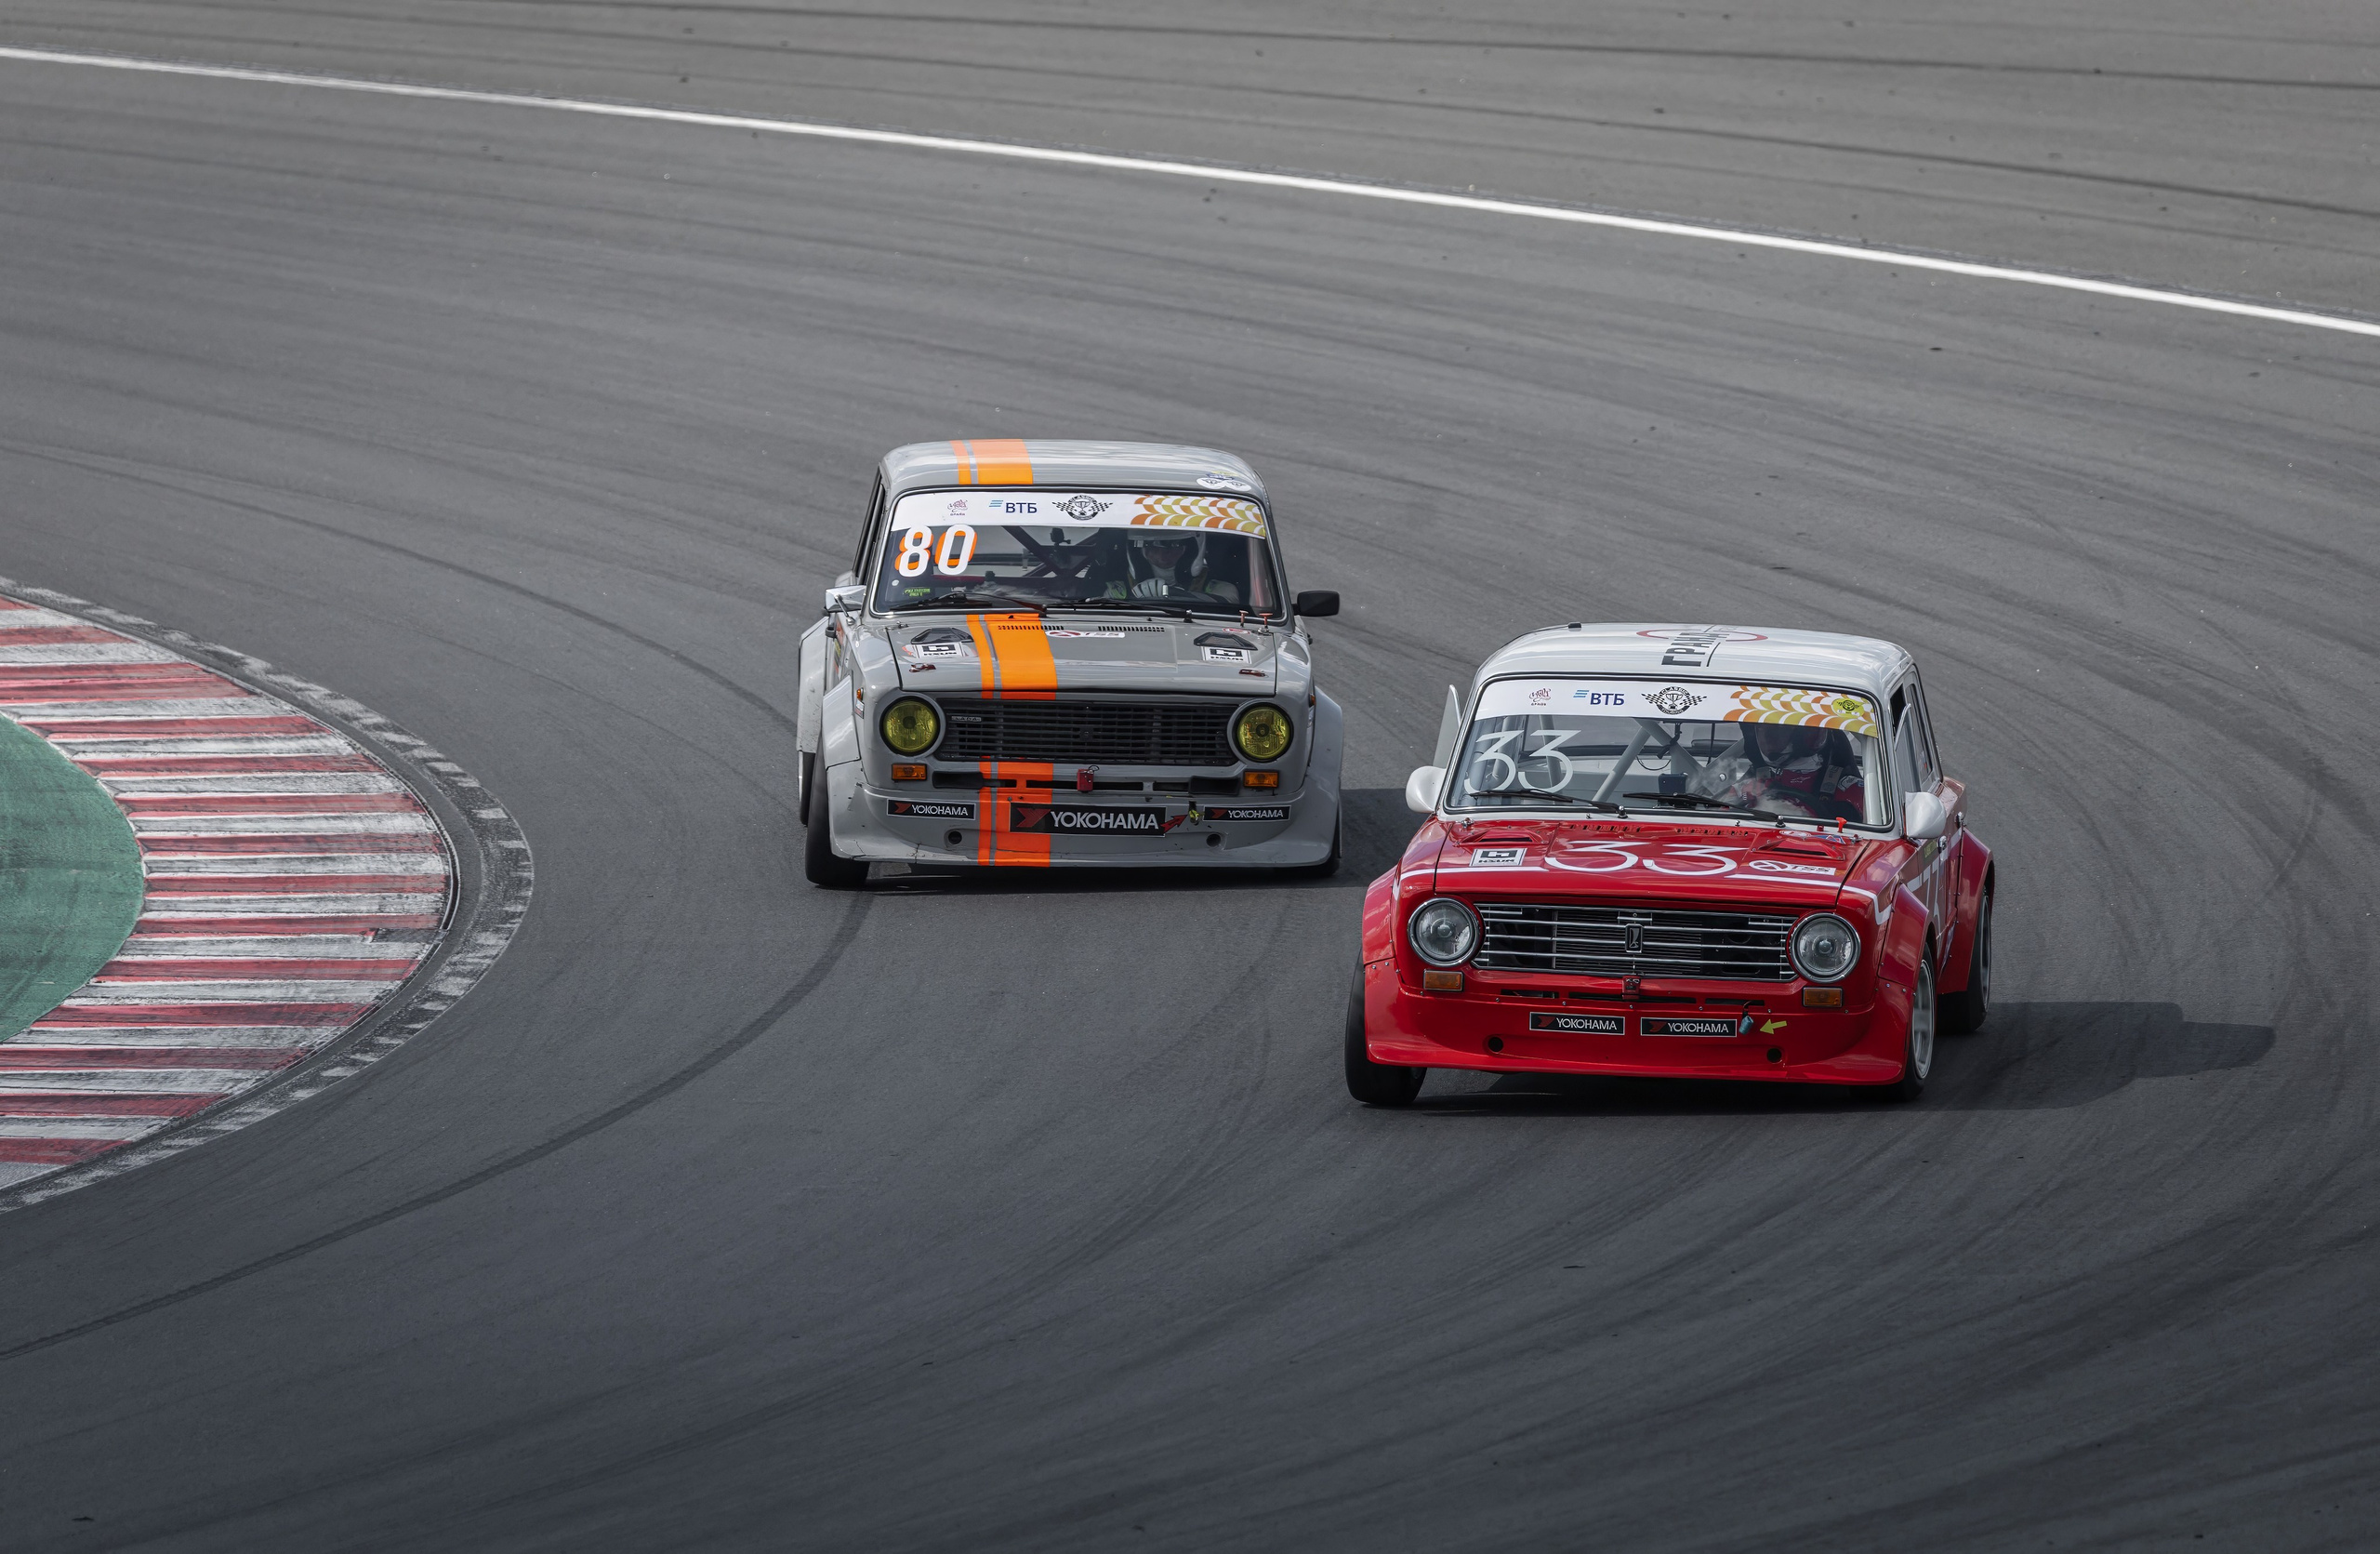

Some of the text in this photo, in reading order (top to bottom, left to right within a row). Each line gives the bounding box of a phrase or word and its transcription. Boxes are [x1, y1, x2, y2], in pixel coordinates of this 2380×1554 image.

[1005, 502, 1038, 514] ВТБ
[894, 523, 977, 578] 80
[1590, 692, 1625, 707] ВТБ
[1463, 729, 1582, 795] 33
[911, 804, 969, 817] YOKOHAMA
[1228, 809, 1284, 818] YOKOHAMA
[1051, 810, 1159, 830] YOKOHAMA
[1544, 840, 1750, 876] 33
[1555, 1016, 1618, 1030] YOKOHAMA
[1667, 1022, 1729, 1033] YOKOHAMA
